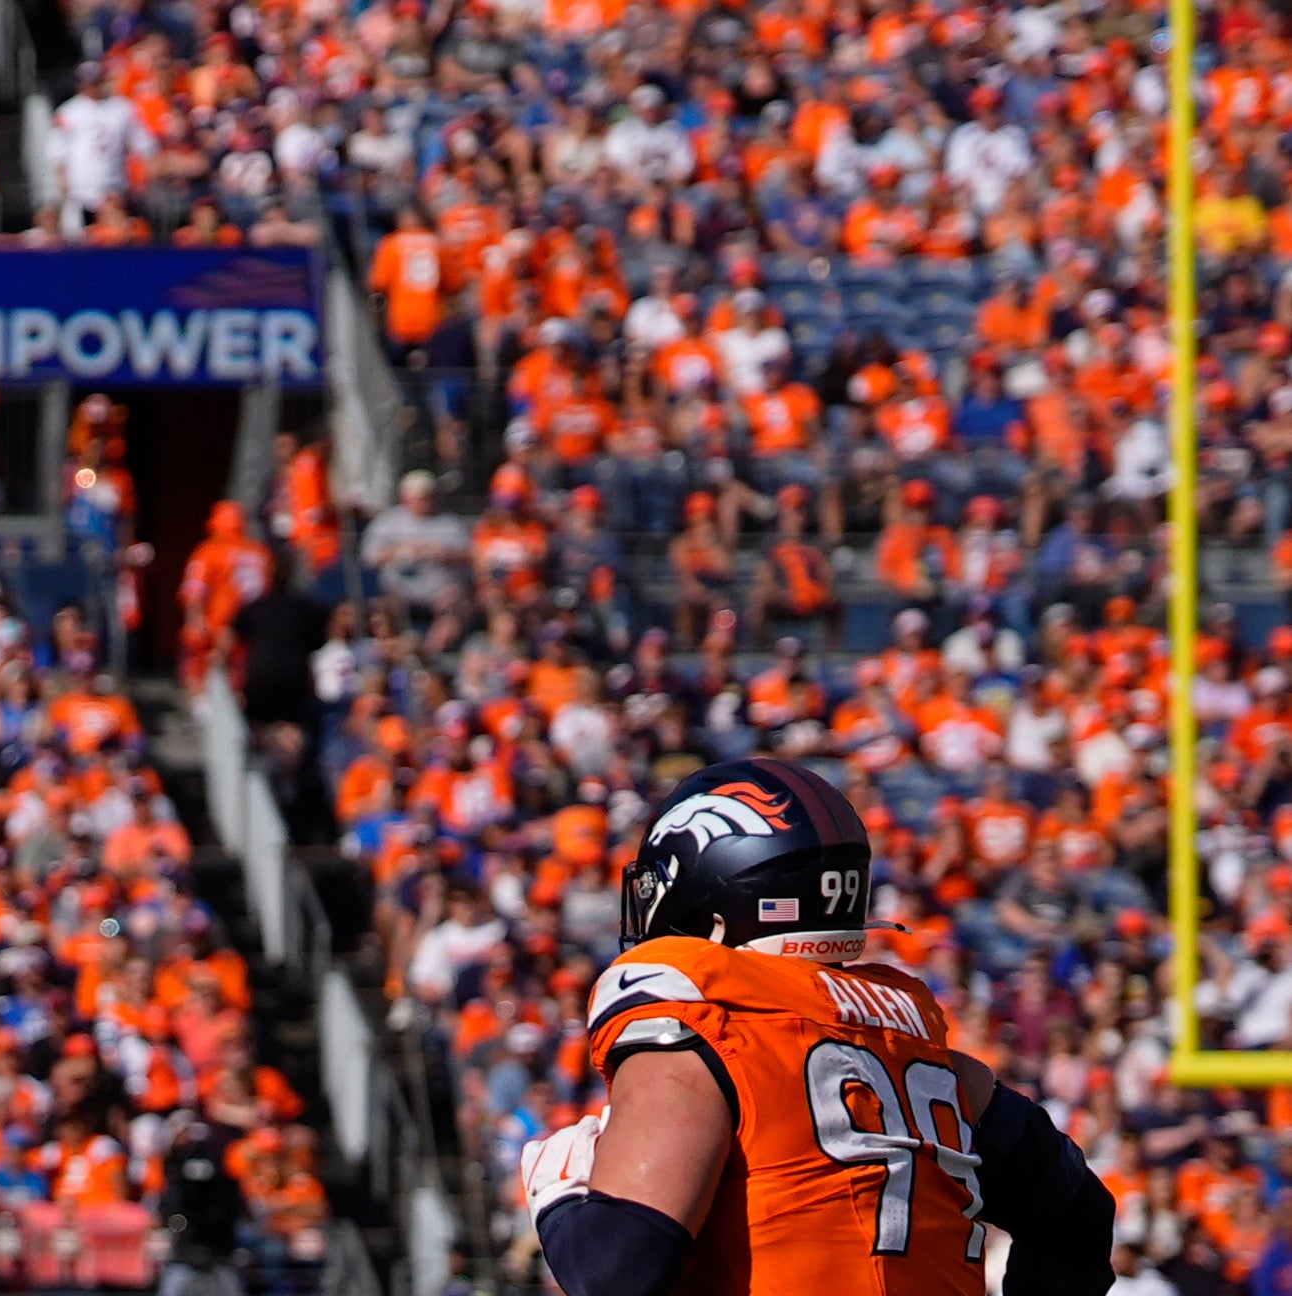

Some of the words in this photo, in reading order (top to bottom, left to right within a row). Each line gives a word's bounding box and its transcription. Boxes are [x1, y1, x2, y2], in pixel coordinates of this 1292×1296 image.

[820, 868, 860, 915] 99
[817, 969, 931, 1041] ALLEN
[805, 1040, 987, 1261] 99
